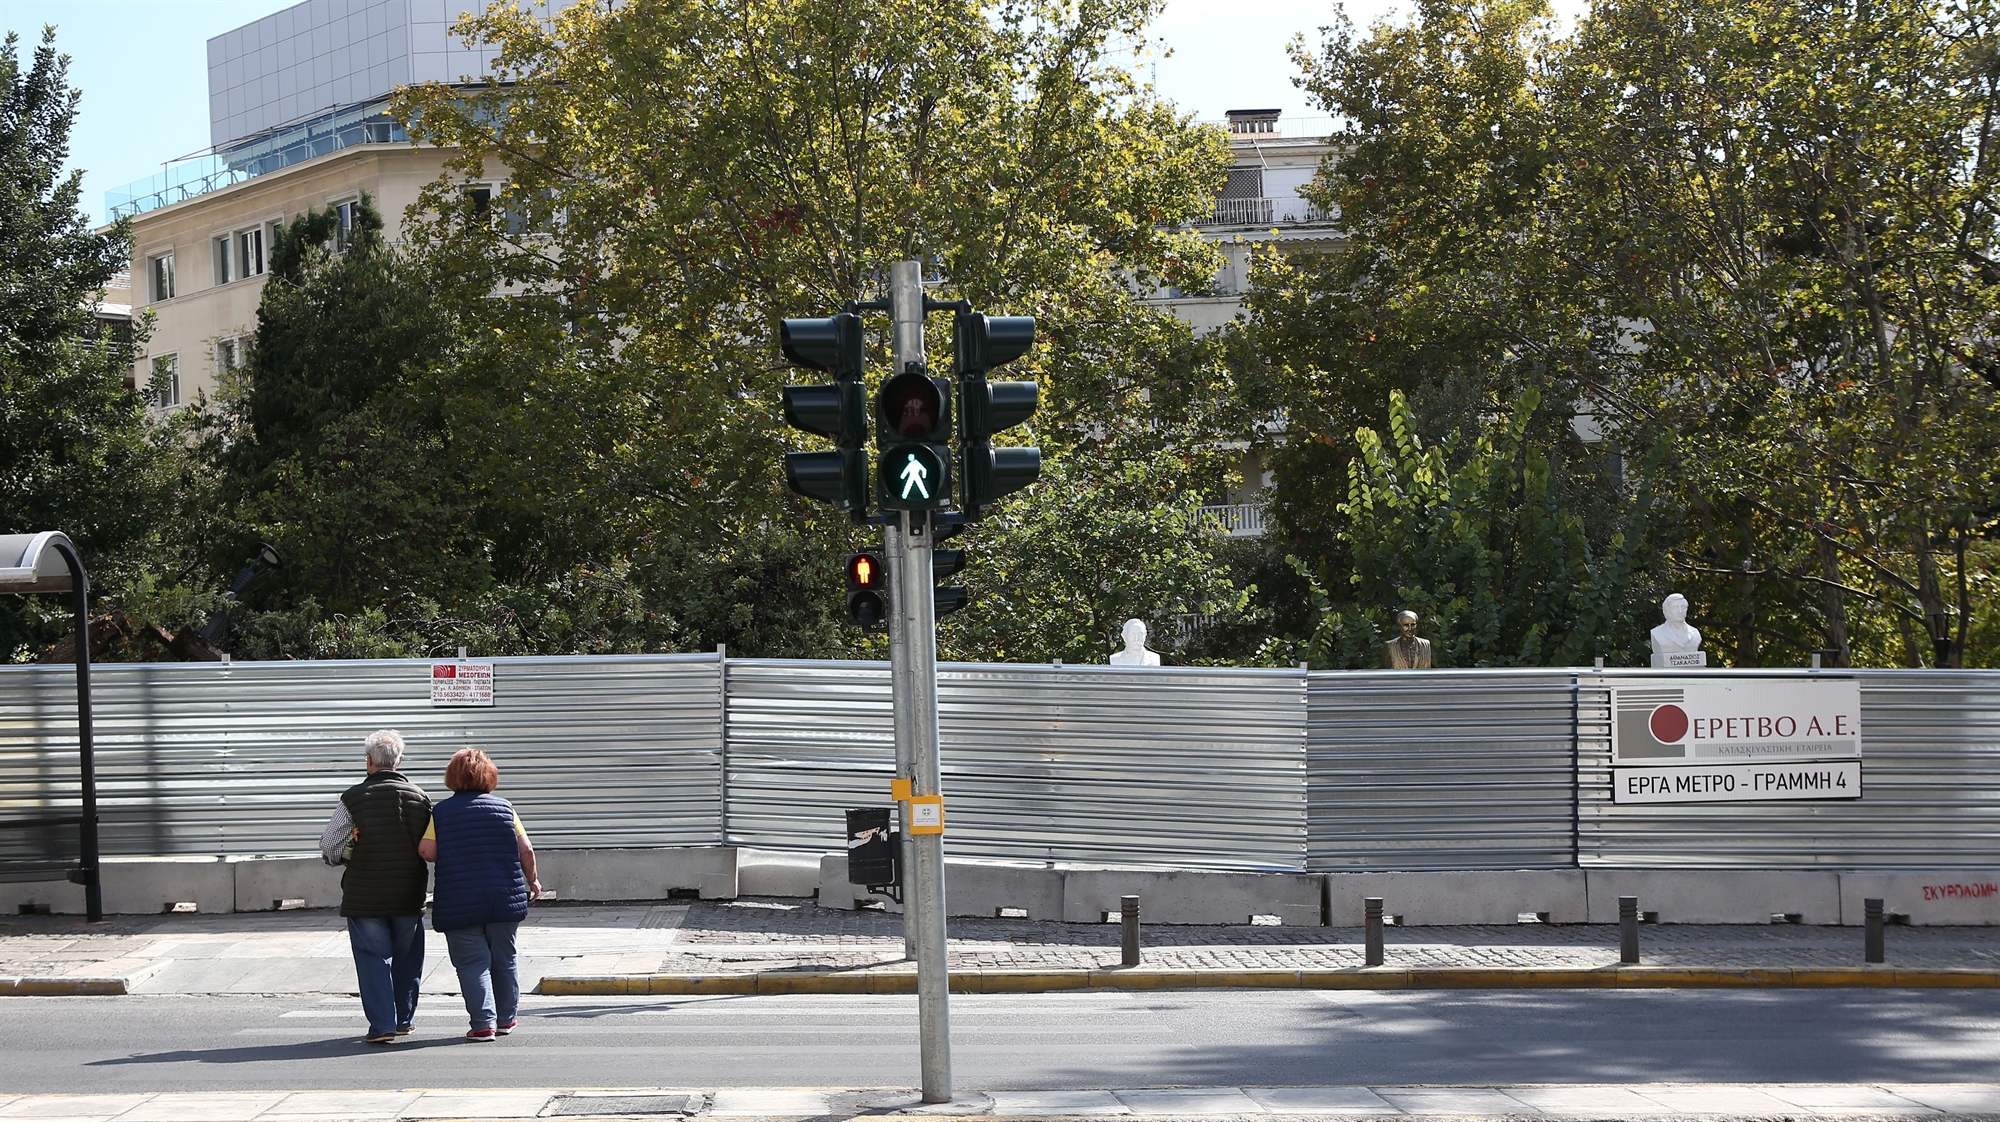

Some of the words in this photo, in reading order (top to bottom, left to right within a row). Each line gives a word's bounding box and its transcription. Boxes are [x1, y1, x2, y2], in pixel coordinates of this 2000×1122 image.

[1693, 716, 1797, 739] ΕΡΕΤΒΟ
[1806, 715, 1856, 737] Α.Ε.
[1718, 745, 1792, 755] ΚΑΤΑΣΚΕΥΑΣΤΙΚΗ
[1796, 744, 1833, 752] ΕΤΑΙΡΕΙΑ
[1628, 776, 1671, 795] ΕΡΓΑ
[1676, 774, 1735, 793] ΜΕΤΡΟ
[1754, 771, 1831, 791] ΓΡΑΜΜΗ
[1836, 771, 1847, 789] 4
